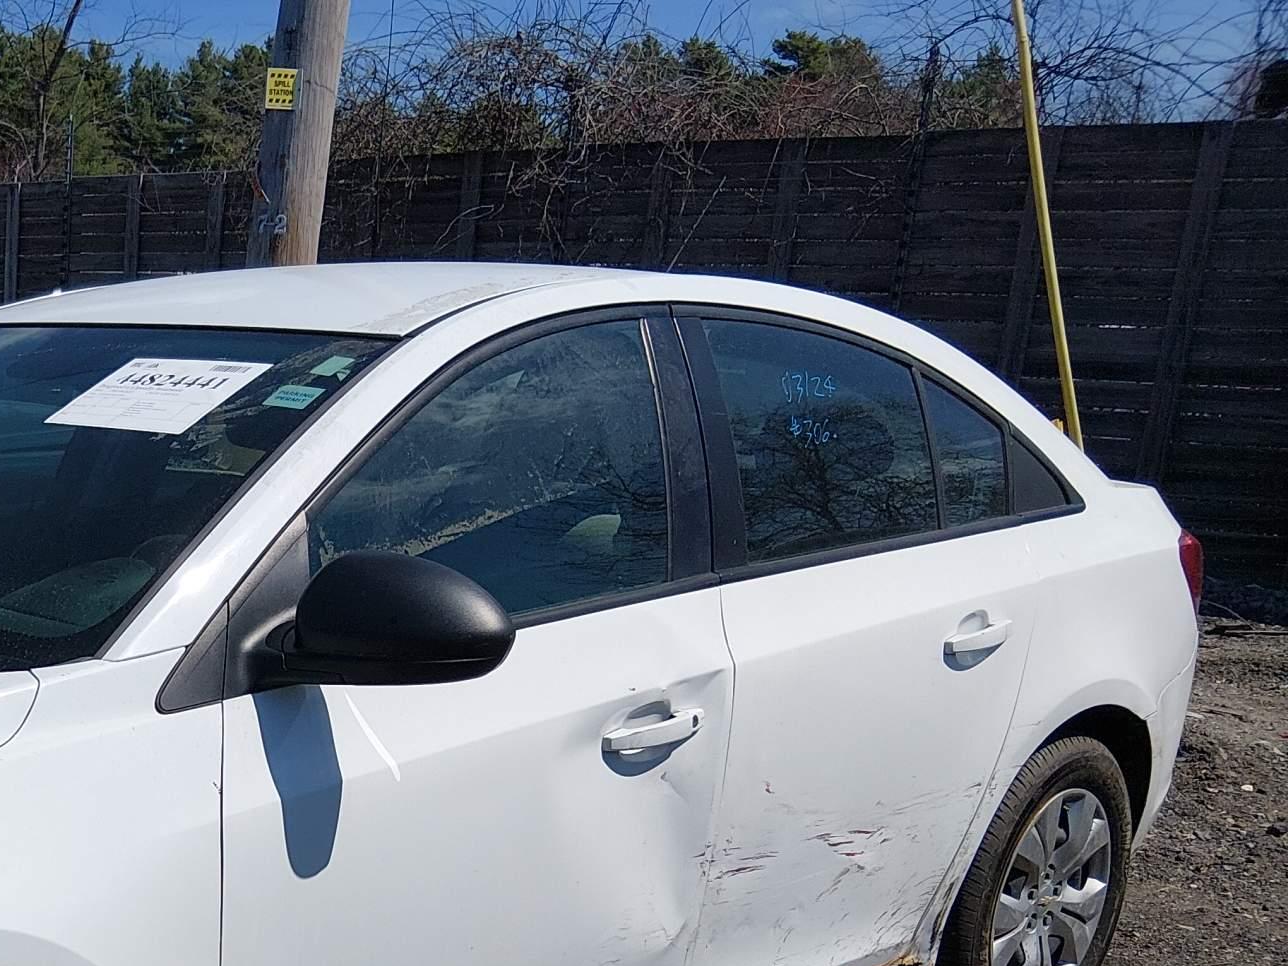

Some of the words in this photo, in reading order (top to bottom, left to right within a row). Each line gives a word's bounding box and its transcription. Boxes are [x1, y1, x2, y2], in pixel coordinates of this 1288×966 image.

[274, 79, 291, 88] SPILL
[269, 88, 293, 97] STATION
[278, 388, 315, 400] PARKING
[274, 395, 309, 405] PERMIT
